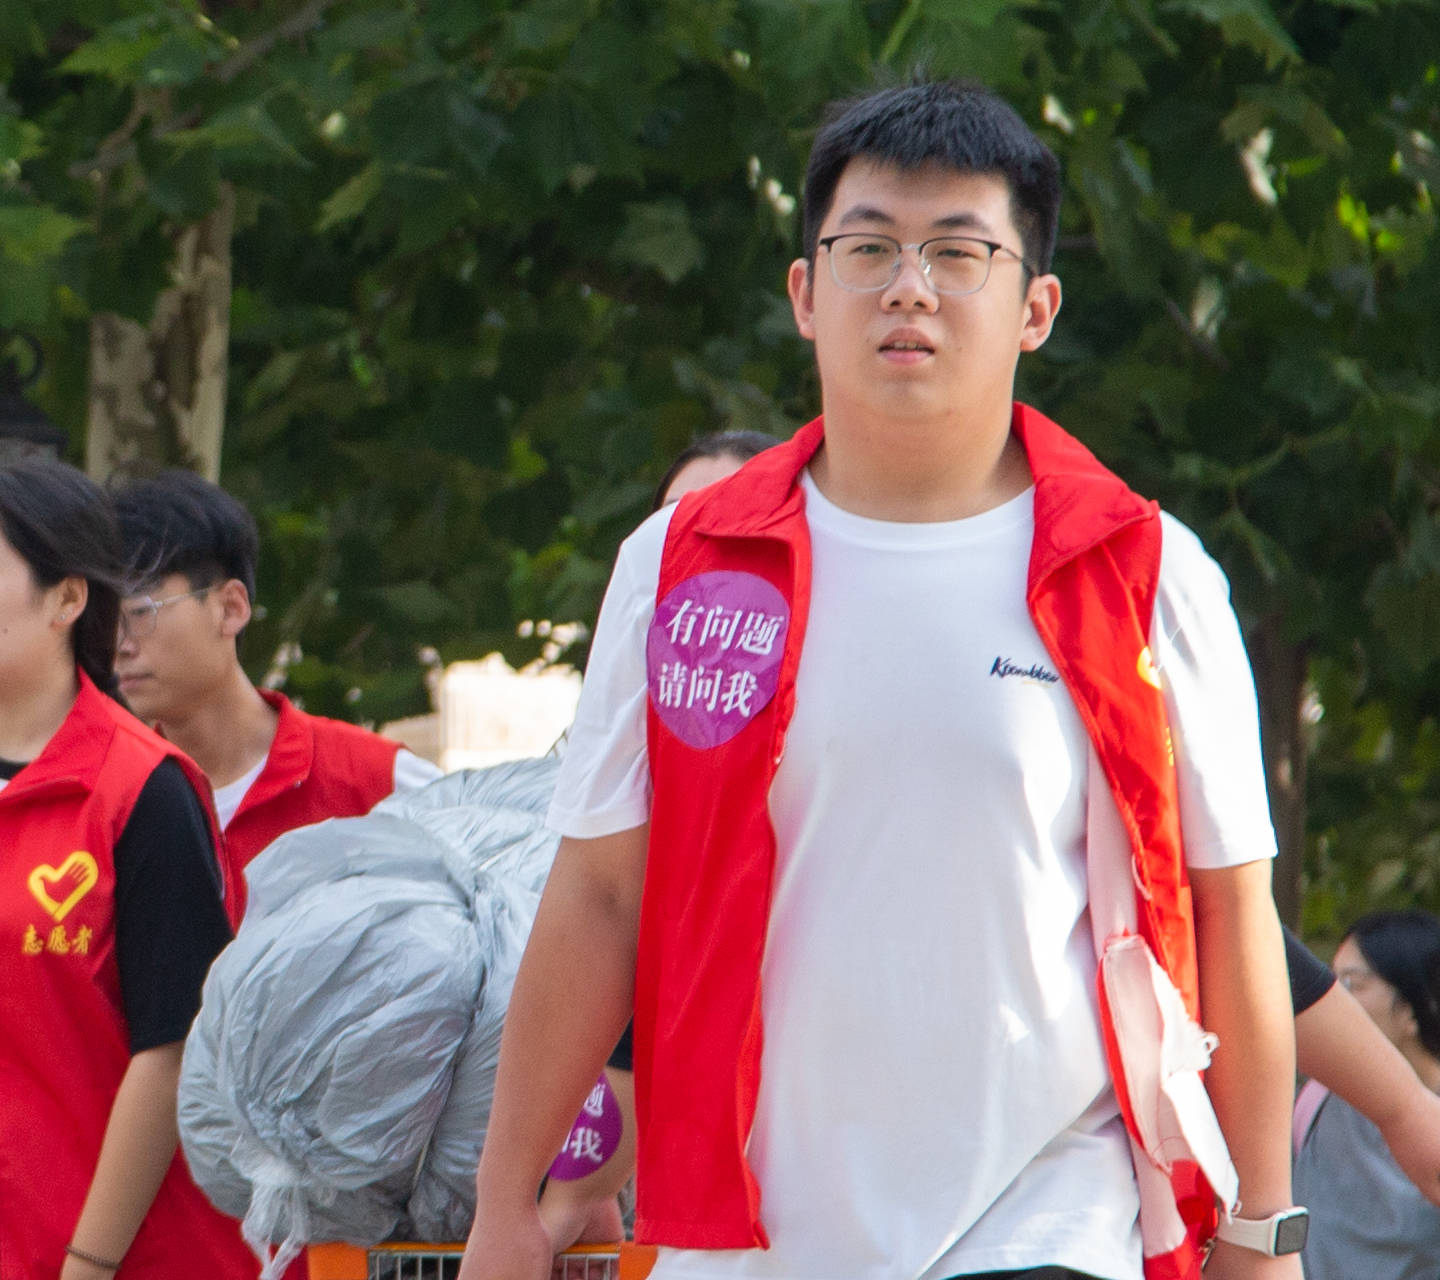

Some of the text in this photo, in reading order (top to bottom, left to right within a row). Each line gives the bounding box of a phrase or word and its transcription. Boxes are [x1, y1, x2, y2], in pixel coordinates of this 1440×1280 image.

[665, 599, 785, 655] 有问题
[659, 662, 758, 718] 请问我
[22, 923, 95, 956] 志愿者
